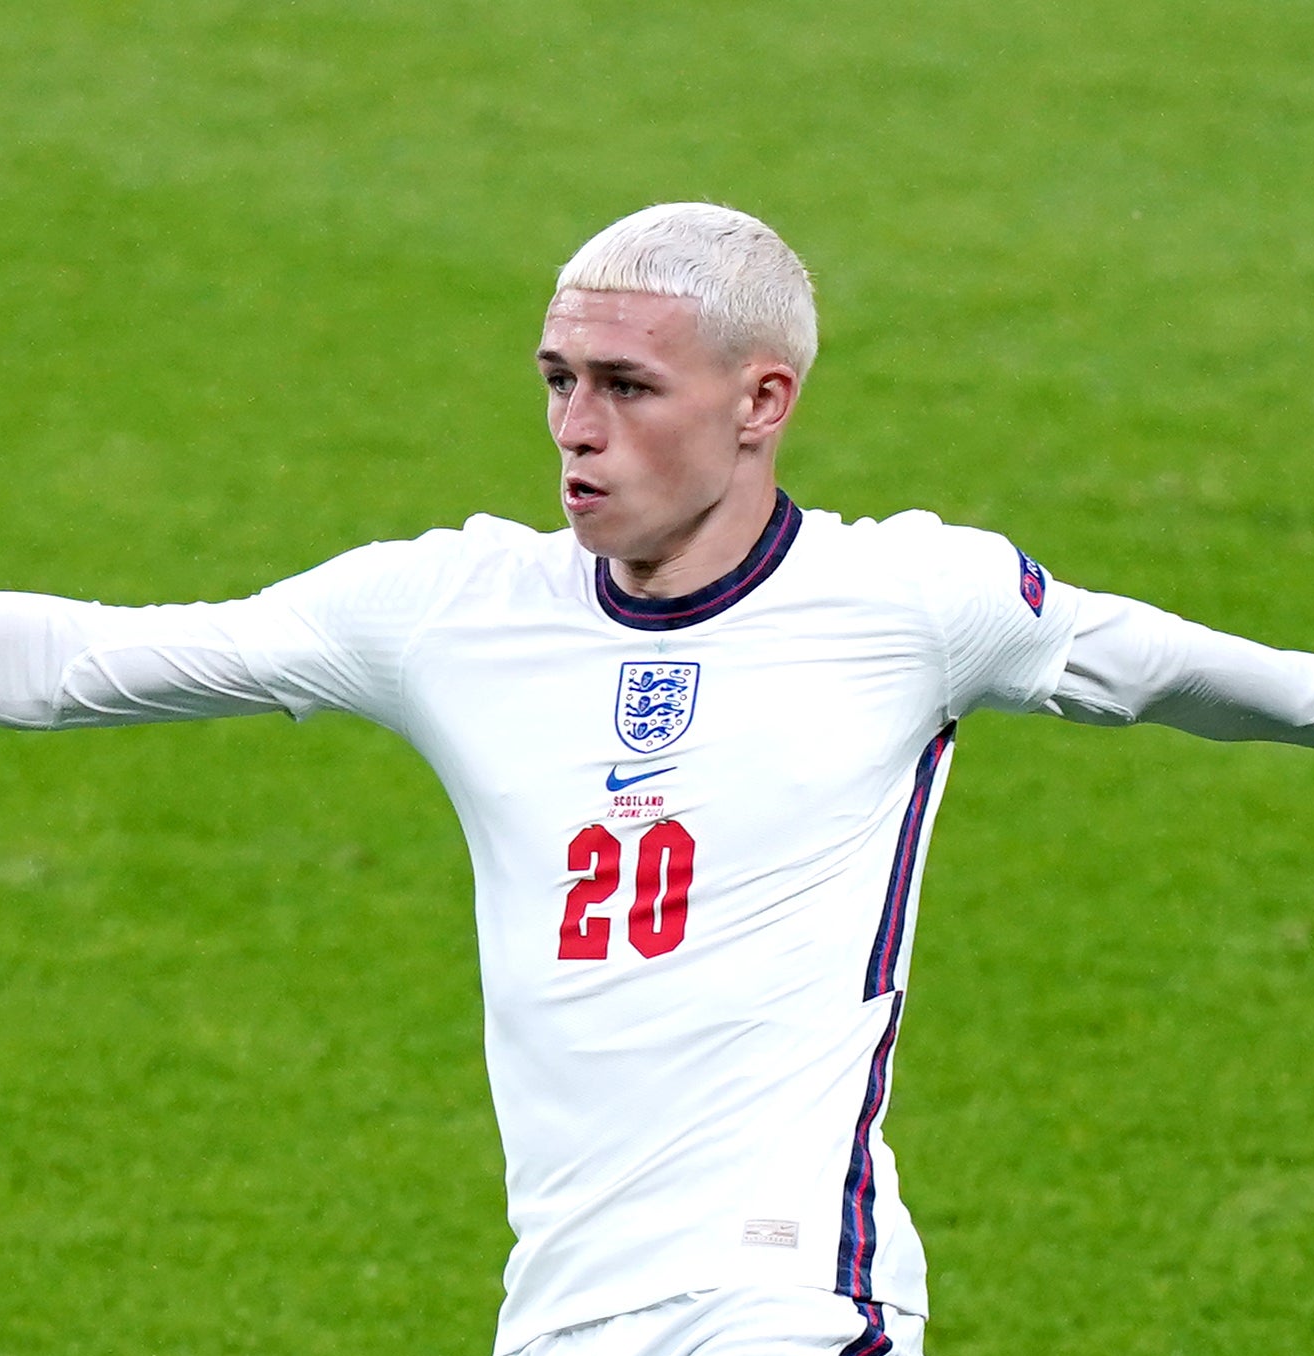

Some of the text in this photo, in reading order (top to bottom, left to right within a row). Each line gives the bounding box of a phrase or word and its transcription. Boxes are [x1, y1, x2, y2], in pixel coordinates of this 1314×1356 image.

[613, 795, 664, 807] SCOTLAND
[618, 808, 642, 818] JUNE
[557, 819, 696, 960] 20
